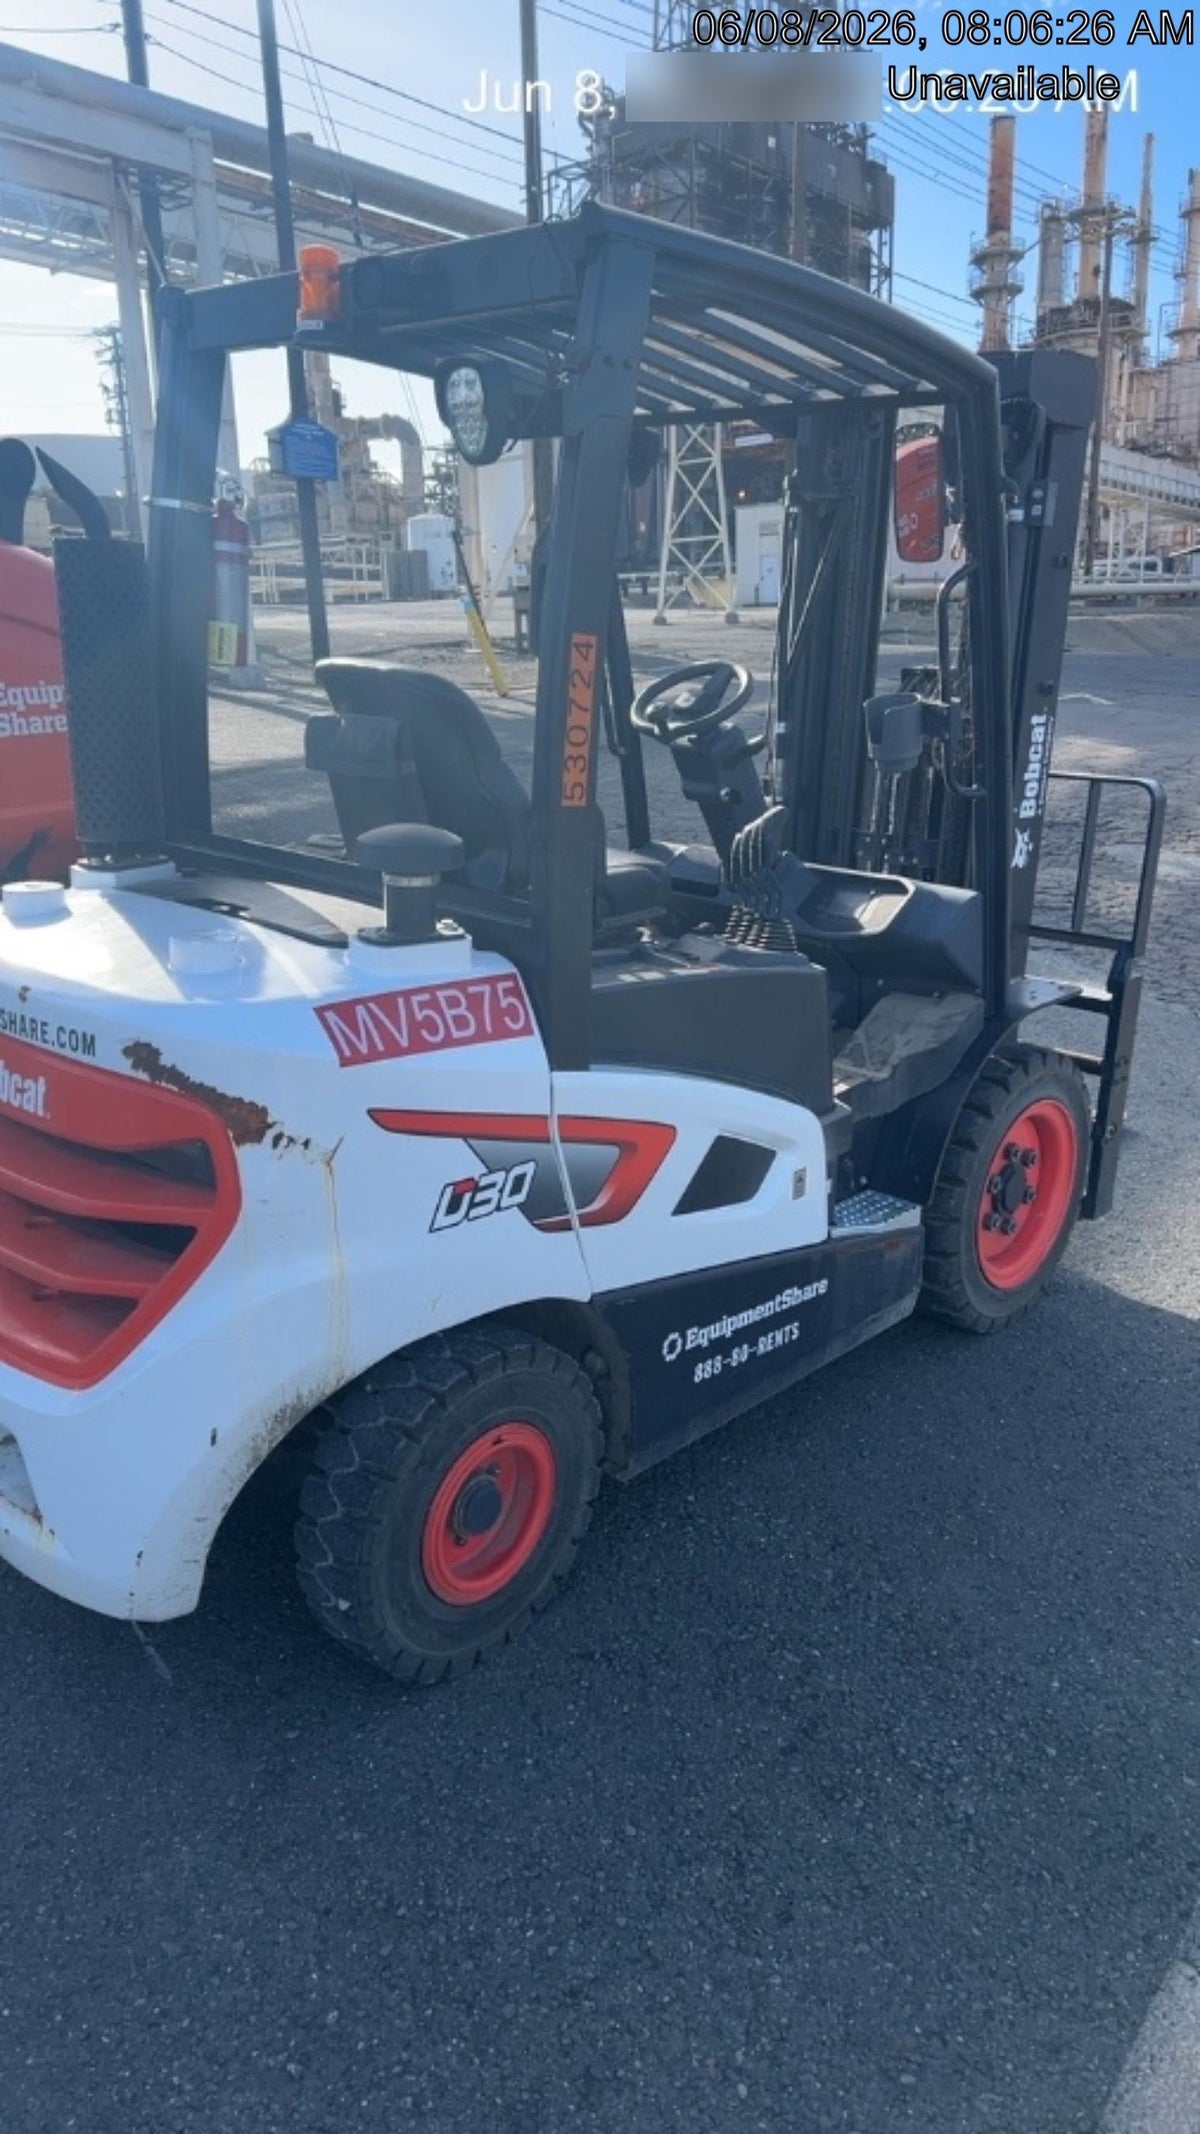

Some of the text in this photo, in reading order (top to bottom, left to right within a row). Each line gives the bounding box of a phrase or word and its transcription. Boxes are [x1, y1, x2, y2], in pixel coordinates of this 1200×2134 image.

[0, 680, 66, 712] Equip
[0, 711, 68, 738] Share
[564, 642, 594, 801] 530724
[1019, 714, 1047, 819] Bobcat
[323, 981, 526, 1057] MV5B75
[685, 1278, 829, 1351] EquipmentShare
[694, 1322, 800, 1384] 888-80-RENTS
